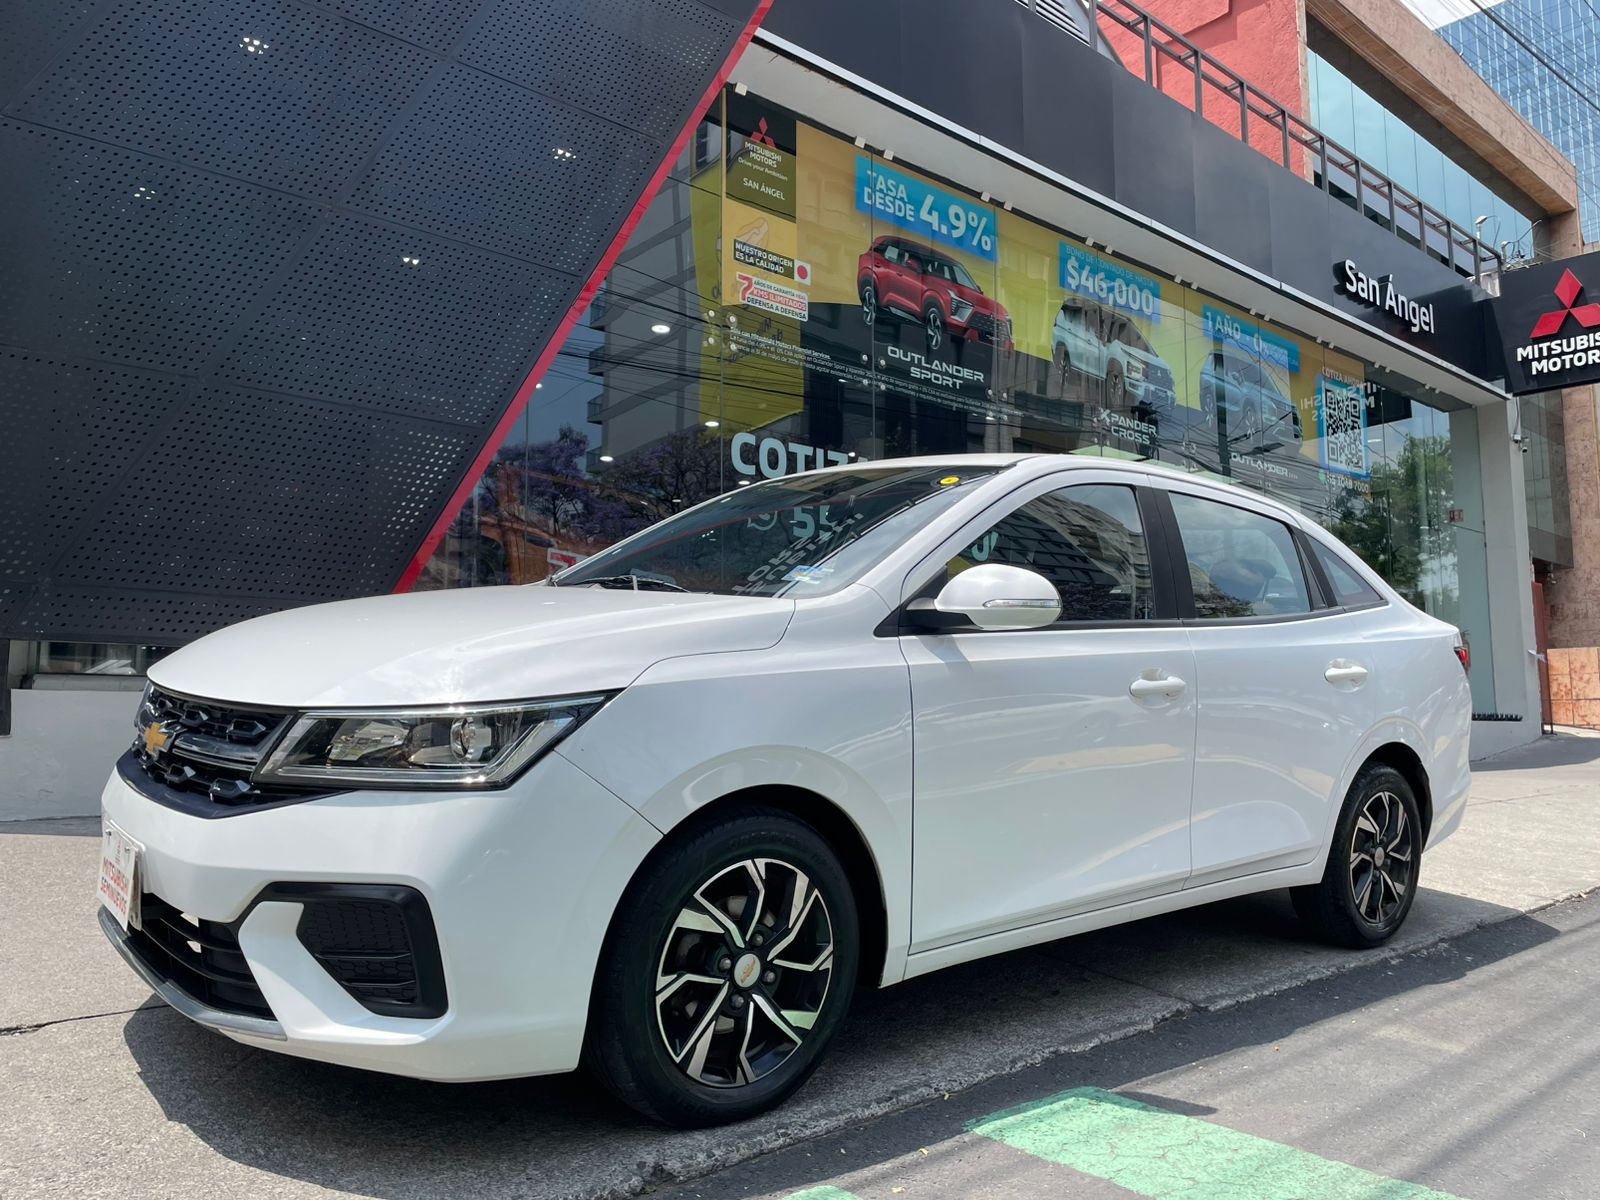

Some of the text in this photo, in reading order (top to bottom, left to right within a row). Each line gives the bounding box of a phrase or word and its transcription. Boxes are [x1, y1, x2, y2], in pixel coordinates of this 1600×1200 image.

[744, 141, 782, 163] MITSUBISHI
[749, 151, 777, 168] MOTORS
[764, 168, 788, 182] Ambition
[866, 170, 908, 202] TASA
[743, 177, 786, 201] SAN ÁNGEL
[863, 186, 915, 222] DESDE
[920, 194, 991, 251] 4.9%
[735, 241, 793, 268] NUESTRO ORIGEN
[735, 251, 785, 273] ES LA CALIDAD
[1066, 246, 1085, 260] BONO
[1085, 254, 1096, 264] DE
[737, 272, 754, 302] 7
[1067, 255, 1154, 316] $46,000
[1345, 259, 1435, 334] San Ángel
[746, 296, 807, 321] DEFENSA A DEFENSA
[753, 288, 807, 311] KMS ILIMITADOS
[1206, 311, 1241, 341] 1 AÑO
[887, 346, 985, 382] OUTLANDER
[1531, 349, 1600, 376] MOTOR
[910, 366, 964, 390] SPORT
[1099, 407, 1158, 437] XPANDER
[1111, 426, 1150, 445] CROSS
[731, 432, 868, 479] COTI
[1231, 452, 1289, 478] OUTLANDER
